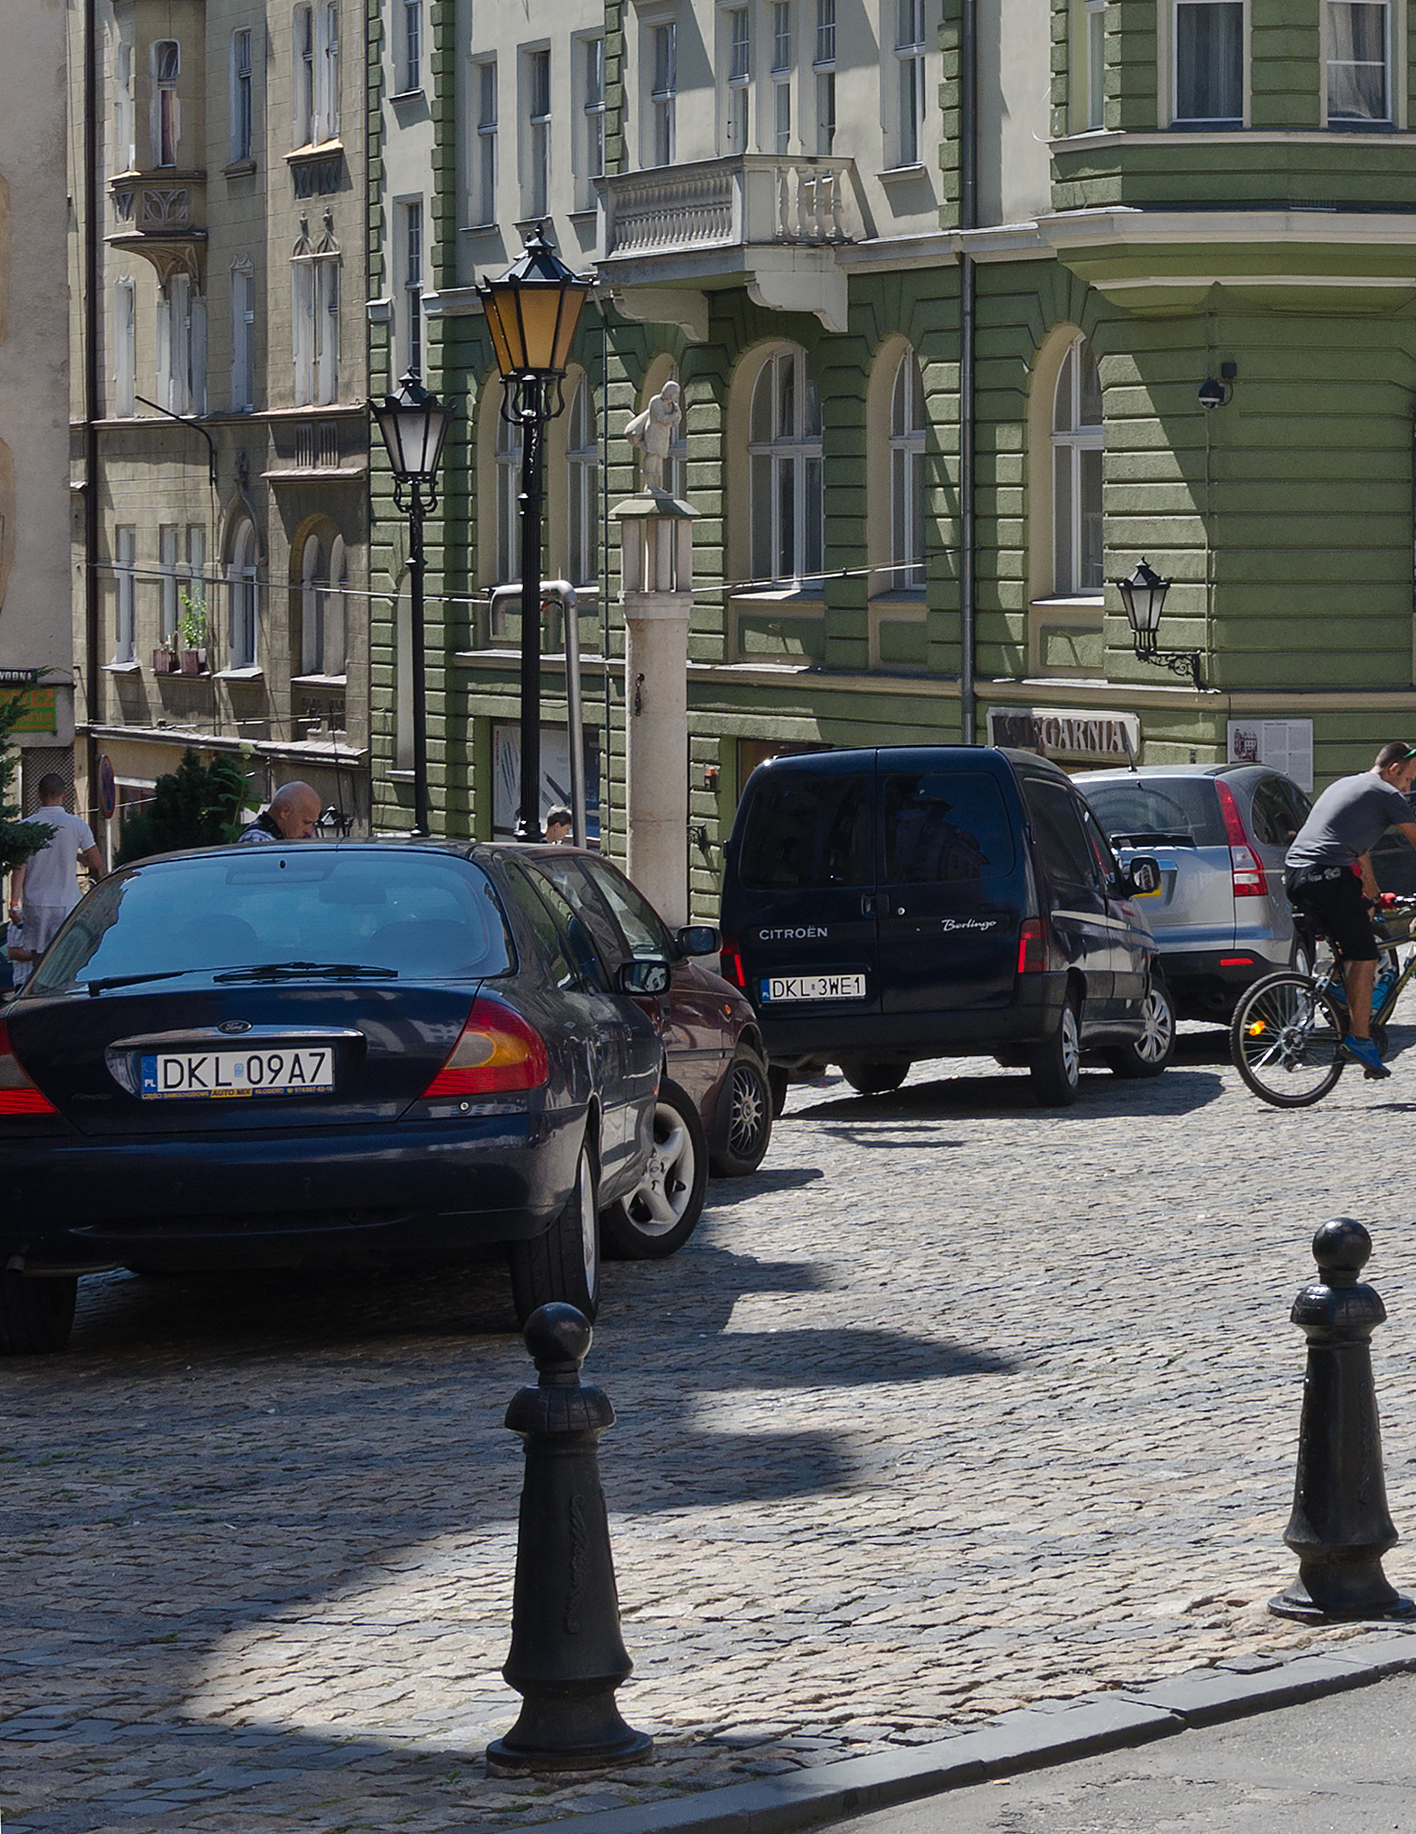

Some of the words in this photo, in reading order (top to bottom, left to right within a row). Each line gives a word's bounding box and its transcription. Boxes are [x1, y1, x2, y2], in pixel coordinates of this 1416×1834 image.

[941, 918, 997, 932] Berlingo
[759, 926, 828, 940] CITROËN
[772, 979, 811, 998] DKL
[818, 977, 863, 996] 3WE1
[224, 1021, 245, 1032] Ford
[163, 1056, 232, 1089] DKL
[247, 1052, 326, 1085] 09A7
[144, 1079, 157, 1088] PL
